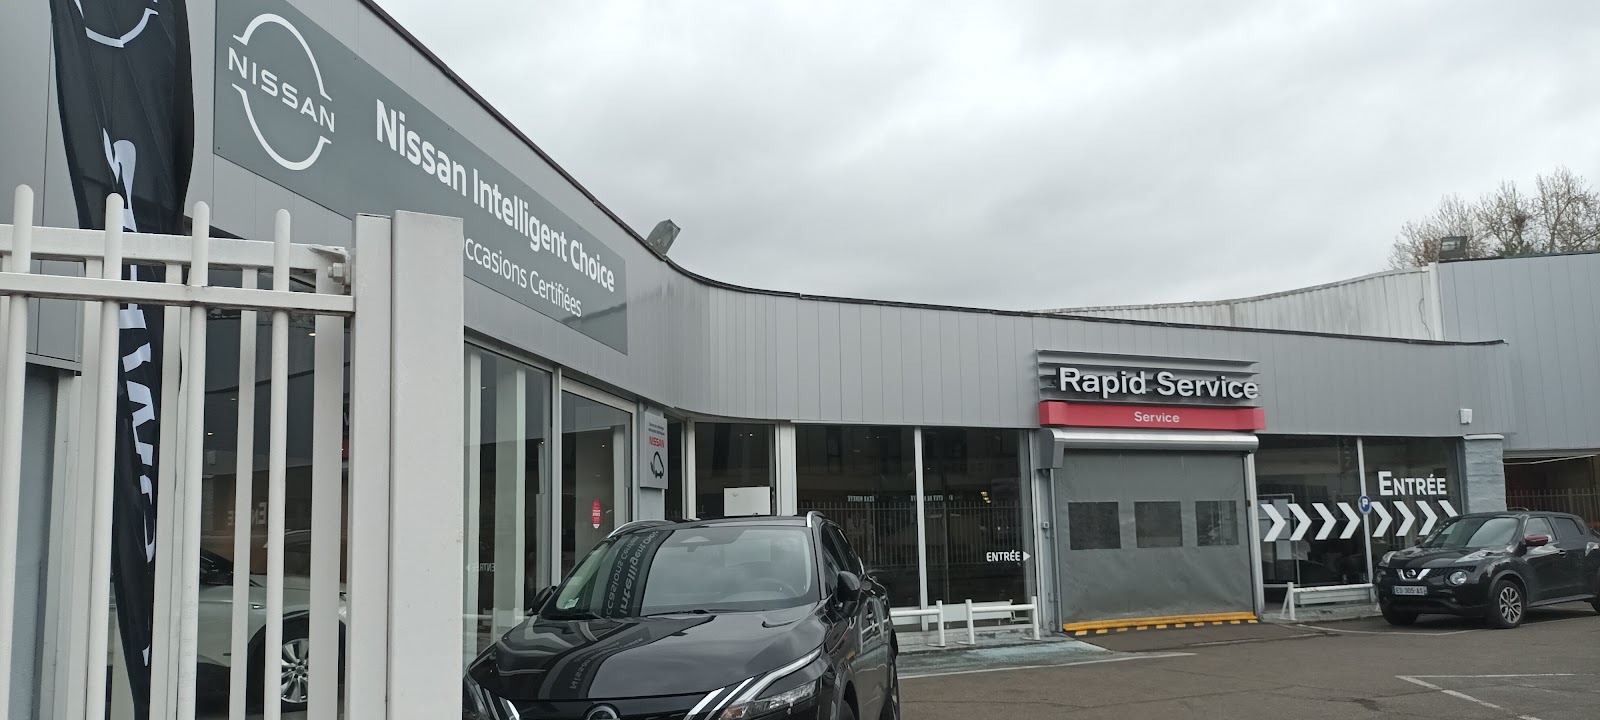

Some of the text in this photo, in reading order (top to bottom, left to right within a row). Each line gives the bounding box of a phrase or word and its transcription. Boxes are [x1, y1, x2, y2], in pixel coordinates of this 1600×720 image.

[228, 46, 335, 135] NISSAN
[376, 98, 615, 293] Nissan Intelligent Choice
[463, 235, 582, 318] ccasions Certifiées
[1059, 366, 1259, 400] Rapid Service
[1134, 411, 1180, 423] Service
[1378, 471, 1448, 497] ENTRÉE
[1361, 498, 1369, 508] P
[986, 549, 1021, 563] ENTRÉE
